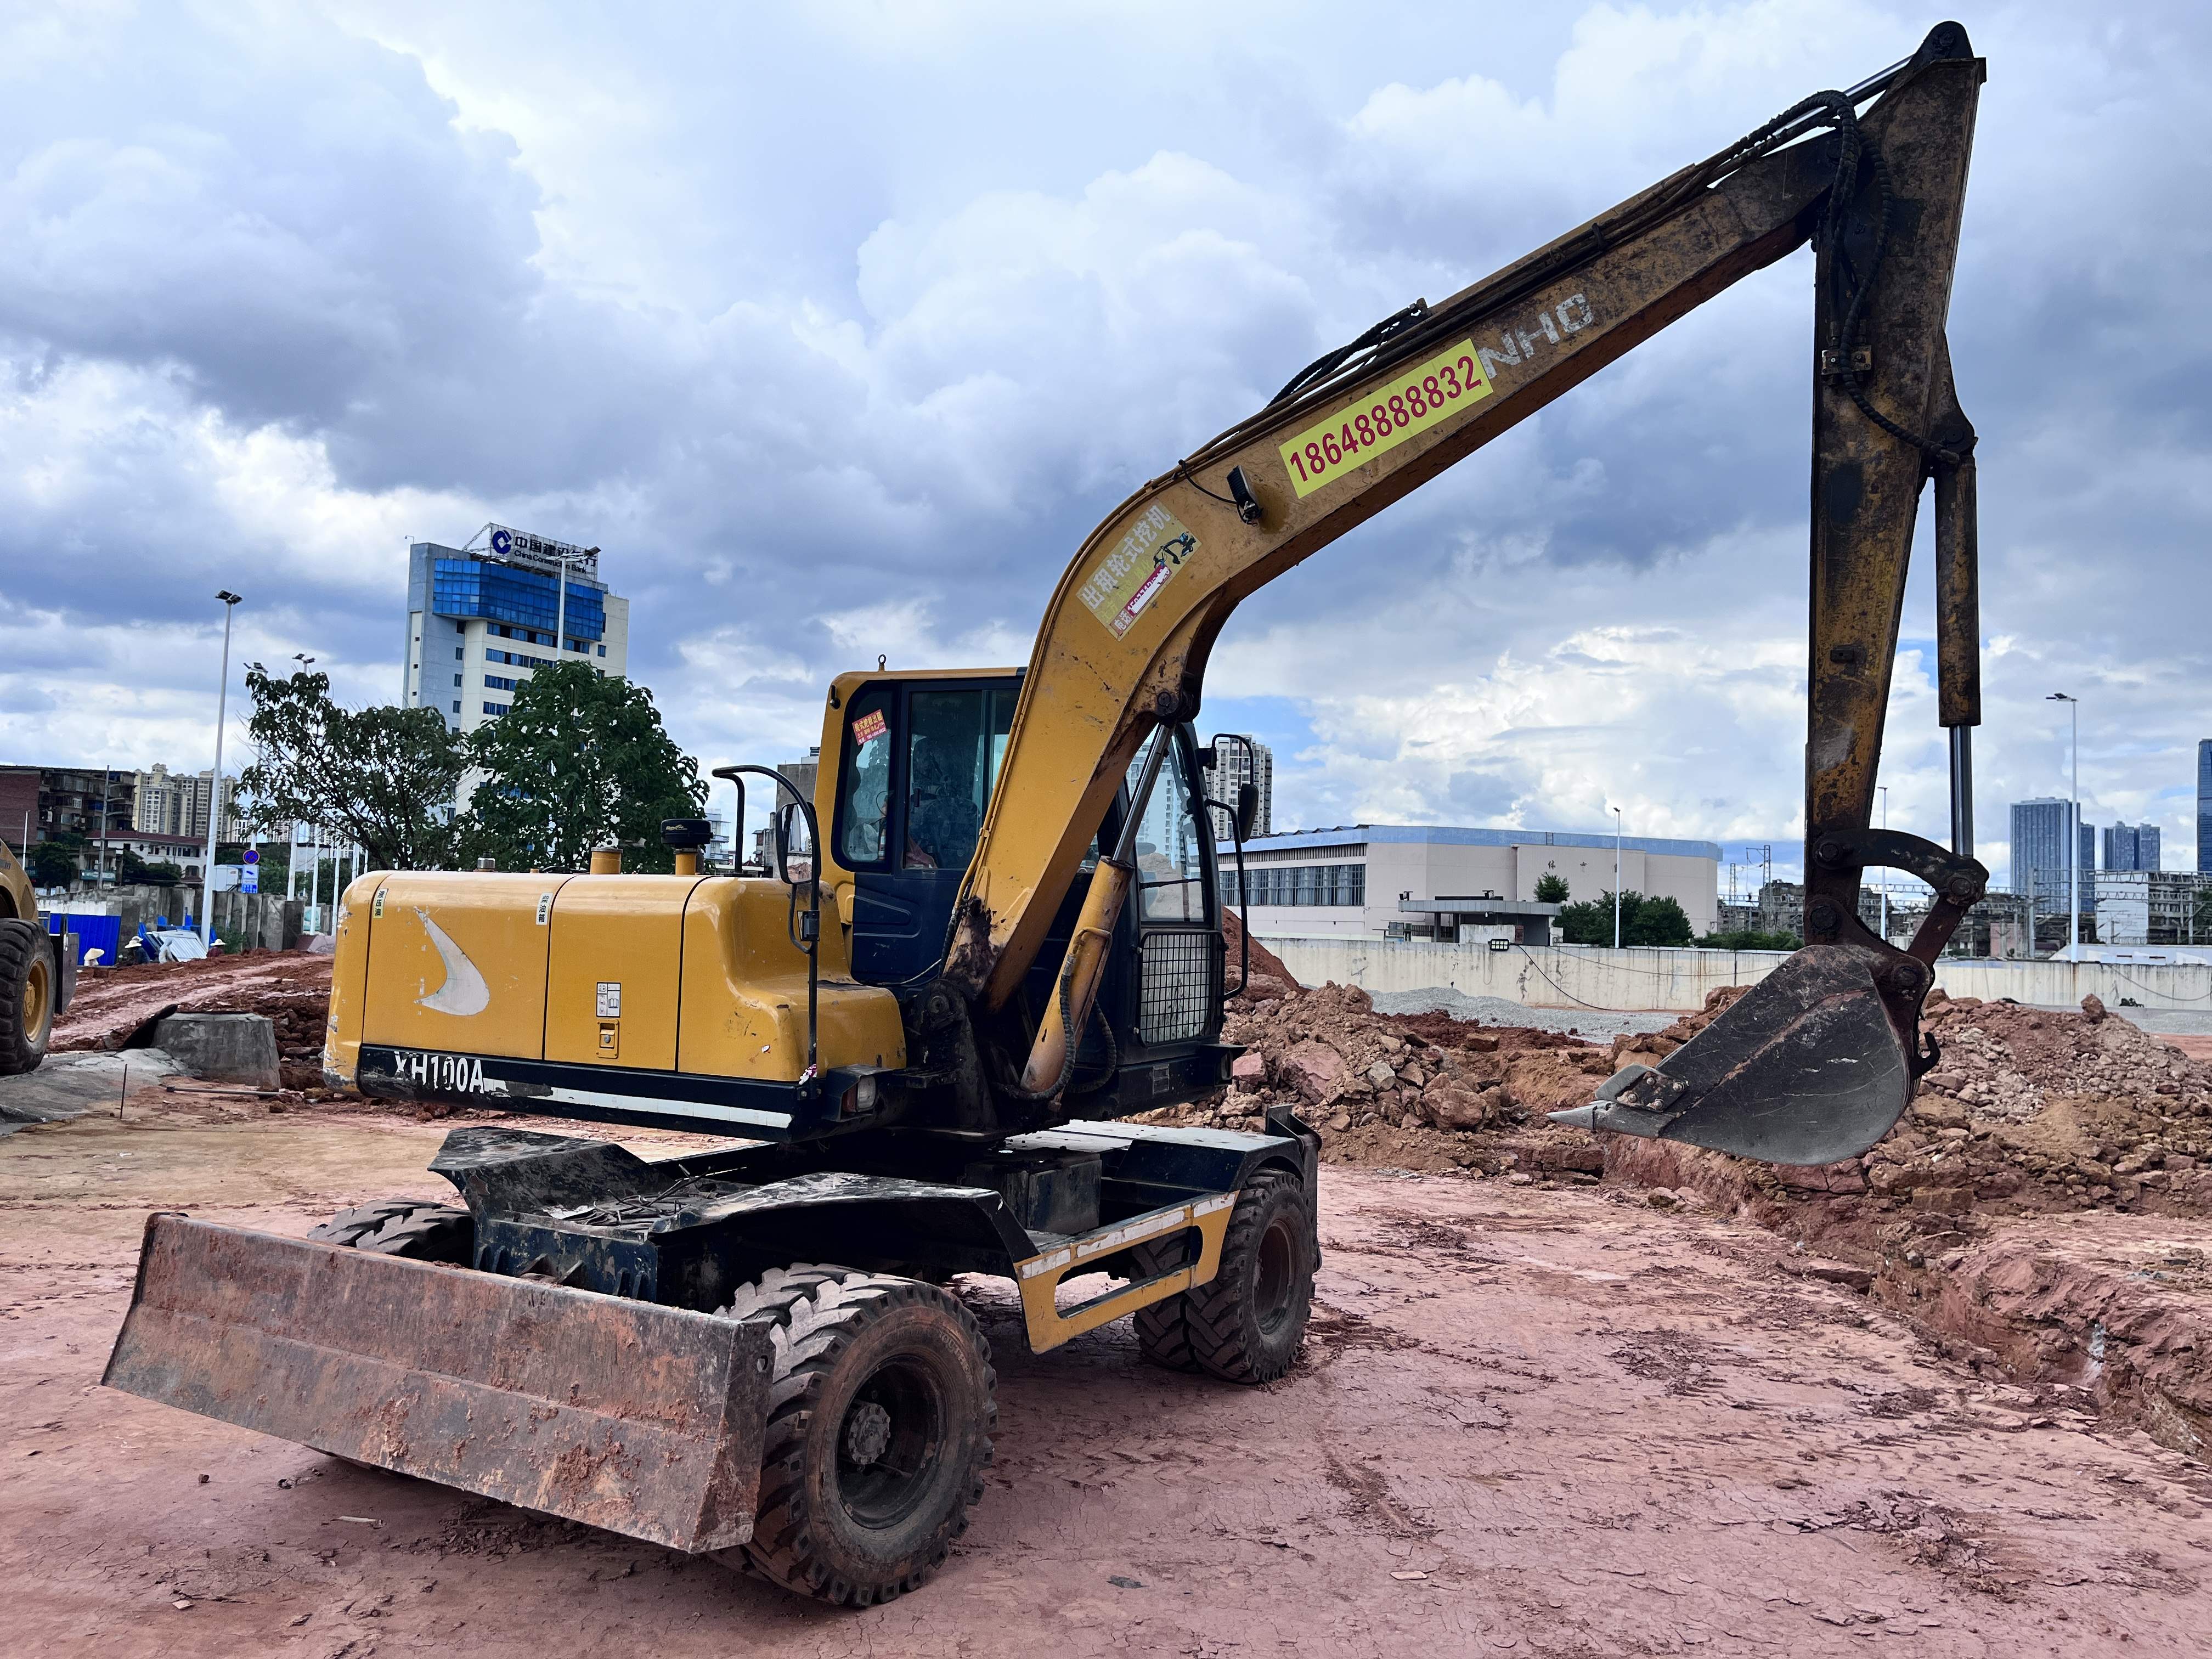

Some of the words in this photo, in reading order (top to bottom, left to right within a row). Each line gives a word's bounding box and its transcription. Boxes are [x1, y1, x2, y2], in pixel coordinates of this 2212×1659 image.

[1290, 356, 1482, 482] 18648888832
[514, 550, 532, 560] China
[571, 564, 586, 574] Bank
[1082, 505, 1171, 610] 出租轮式挖机
